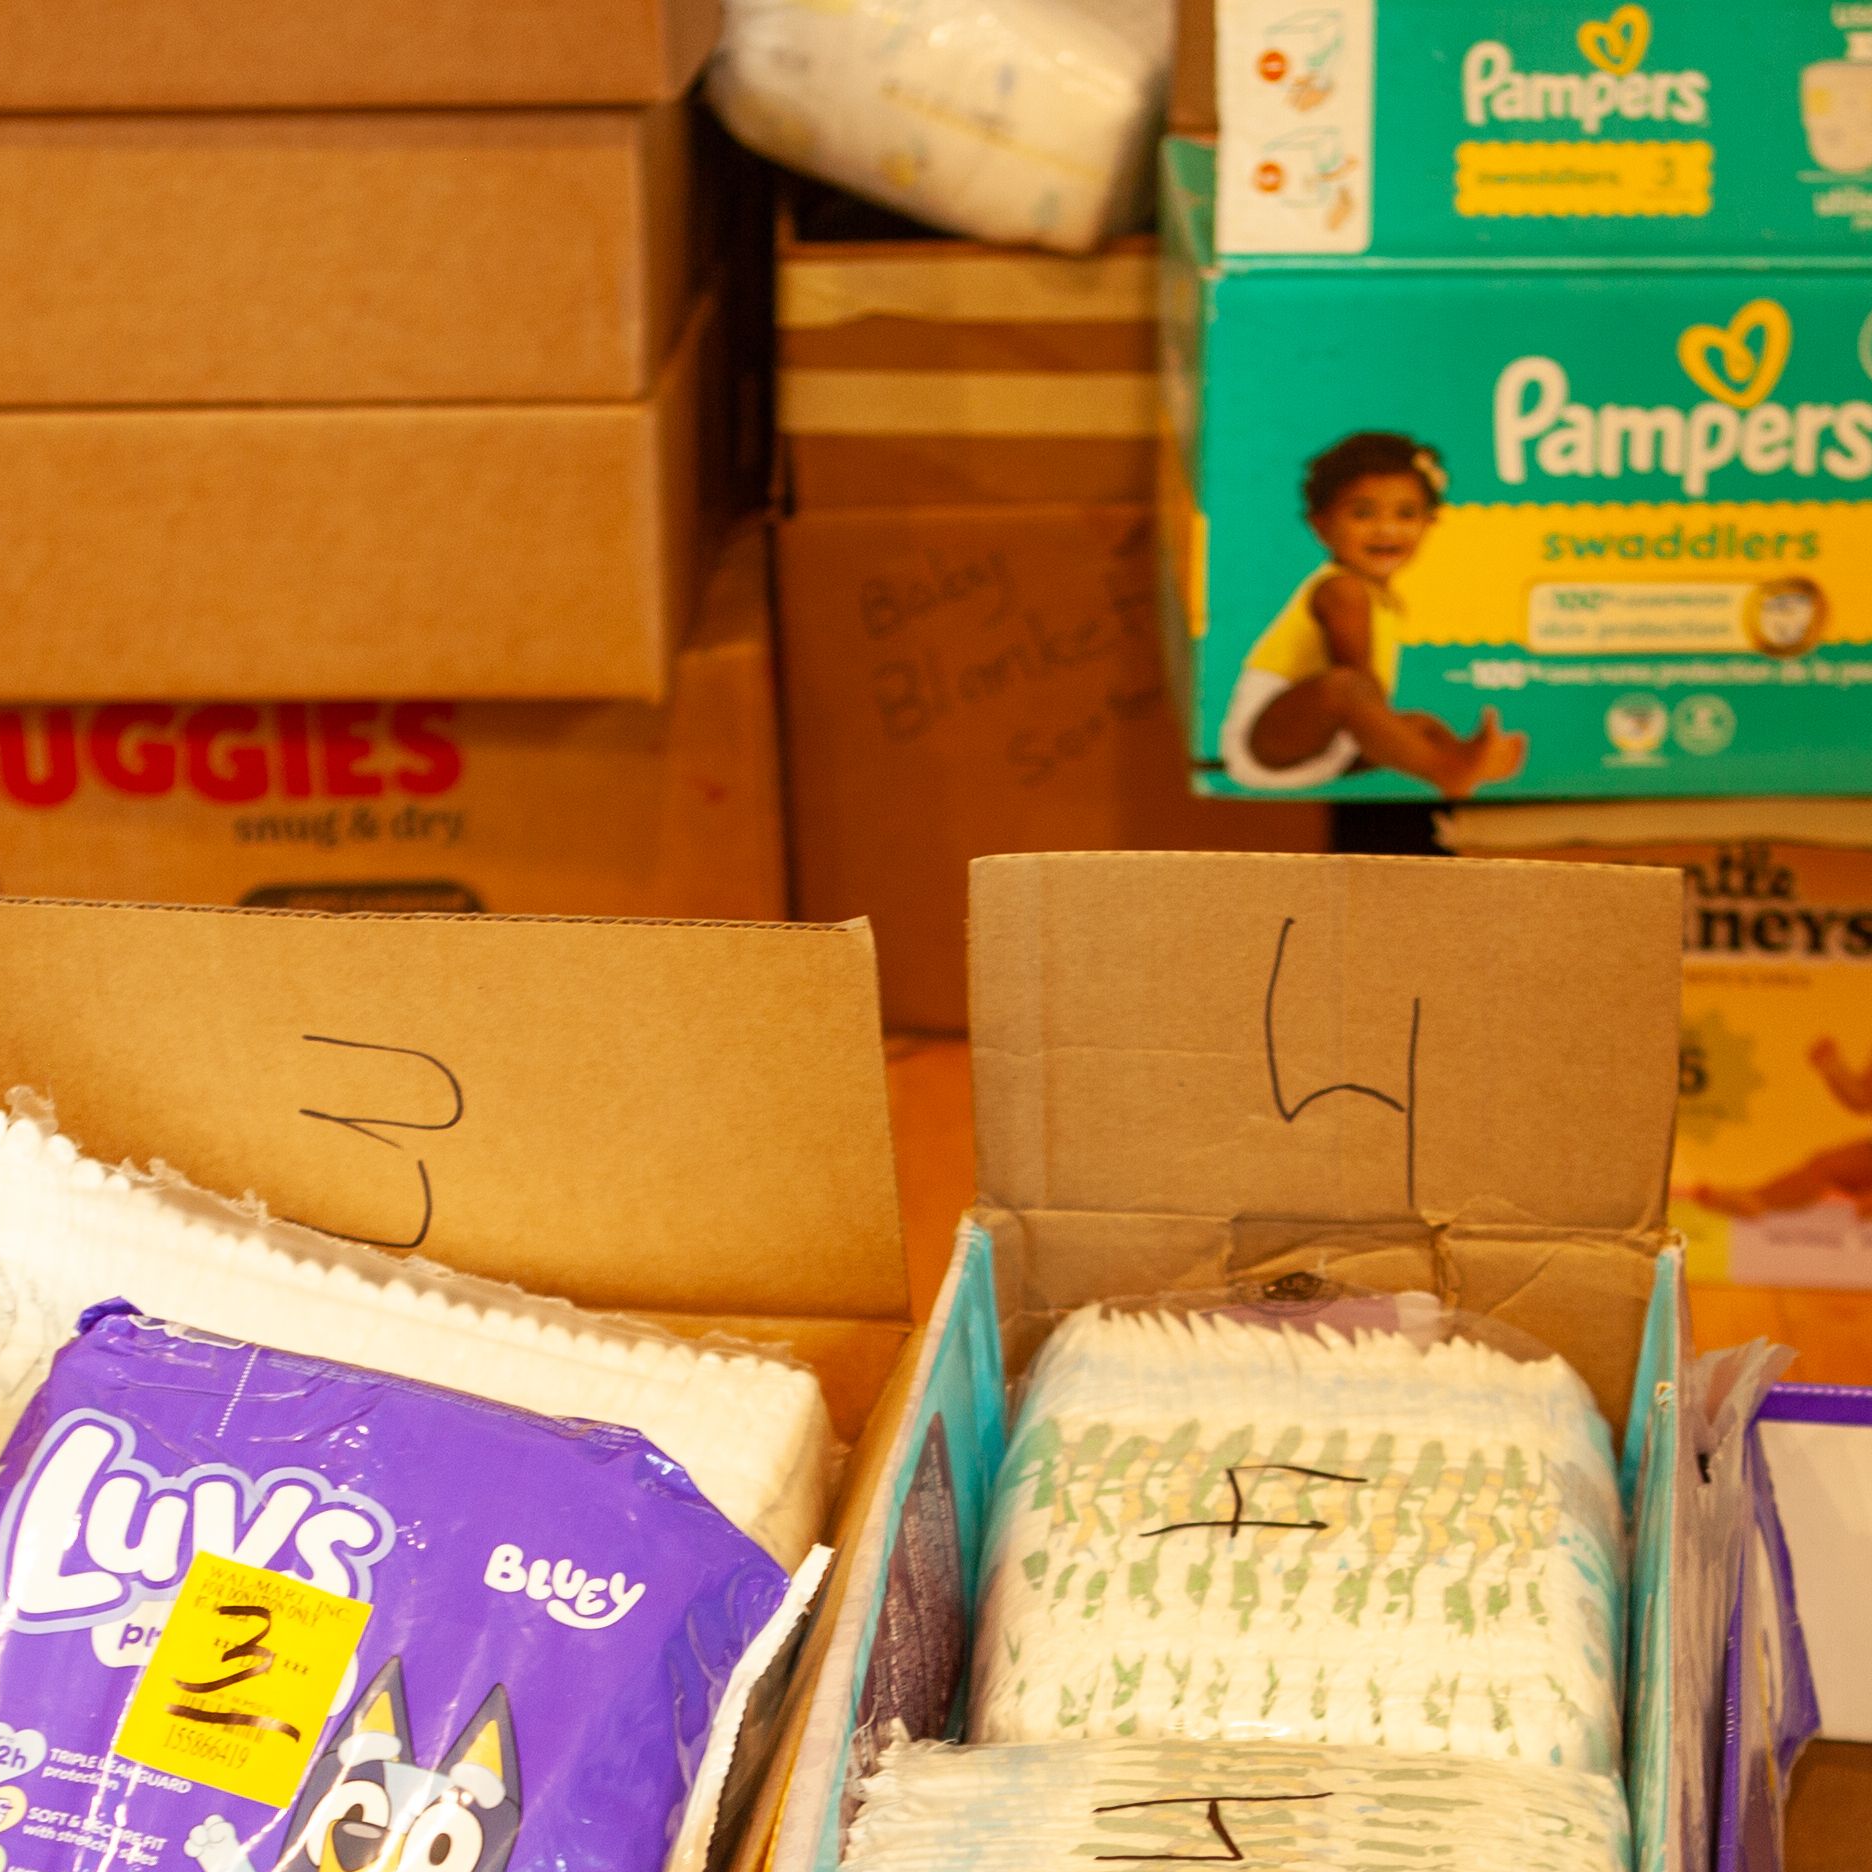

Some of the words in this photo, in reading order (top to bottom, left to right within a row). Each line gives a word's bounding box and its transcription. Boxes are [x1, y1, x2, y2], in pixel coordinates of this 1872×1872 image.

[1464, 41, 1710, 134] Pampers
[1543, 523, 1820, 561] swaddlers
[234, 812, 336, 848] snug
[1266, 917, 1422, 1207] 4
[171, 1604, 280, 1696] 3
[49, 1747, 98, 1770] TRIPLE
[27, 1805, 71, 1827] SOFT
